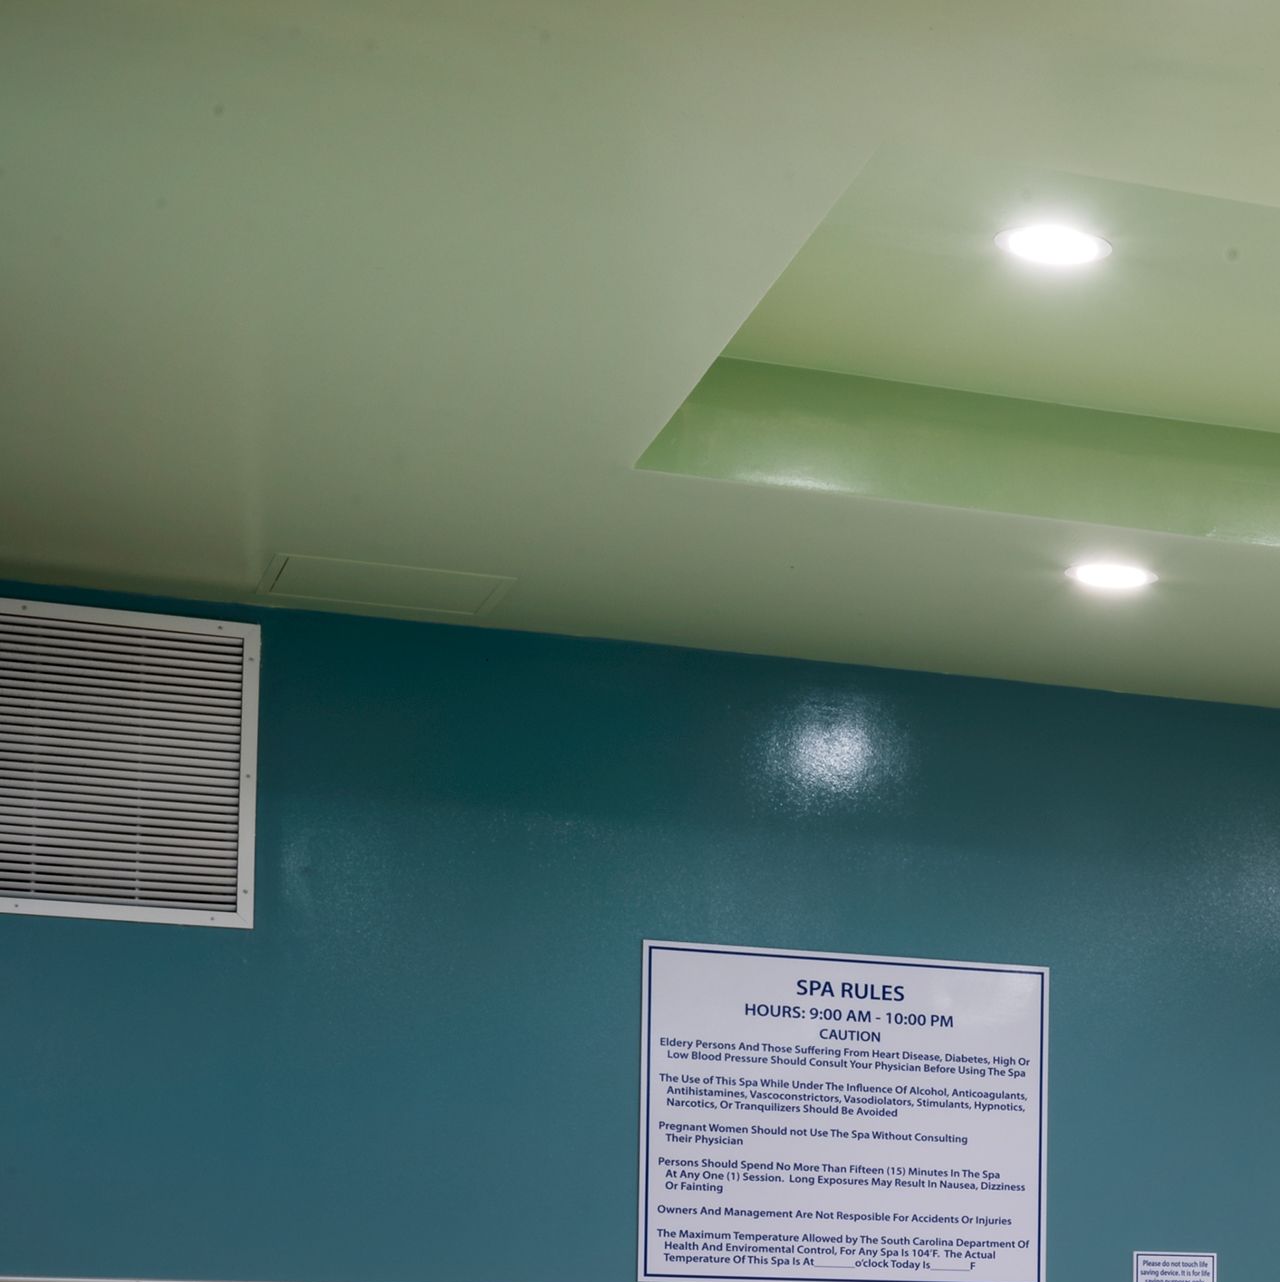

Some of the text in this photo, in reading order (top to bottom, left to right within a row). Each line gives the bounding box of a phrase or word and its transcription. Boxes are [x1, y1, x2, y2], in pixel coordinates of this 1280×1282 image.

[796, 978, 905, 1003] SPA RULES
[744, 1002, 806, 1020] HOURS:
[808, 1007, 843, 1022] 9:00
[845, 1008, 872, 1024] AM
[885, 1011, 927, 1027] 10:00
[930, 1014, 954, 1029] PM
[818, 1028, 881, 1043] CAUTION
[659, 1036, 1031, 1068] Eldery Persons And Those Suffering From Heart Disease, Diabetes, High Or
[666, 1049, 1027, 1080] Low Blood Pressure Should Consult Your Physician Before Using The Spa
[658, 1072, 1028, 1103] The Use of This Spa While Under The Influence Of Alcohol, Anticoagulants,
[666, 1085, 748, 1100] Antihistamines,
[749, 1089, 843, 1105] Vascoconstrictors,
[916, 1097, 972, 1111] Stimulants,
[973, 1100, 1026, 1113] Hypnotics,
[666, 1097, 899, 1118] Narcotics, Or Tranquilizers Should Be Avoided
[658, 1120, 969, 1146] Pregnant Women Should not Use The Spa Without Consulting
[664, 1132, 744, 1147] Their Physician
[656, 1204, 1013, 1227] Owners And Management Are Not Resposible For Accidents Or Injuries
[656, 1228, 1031, 1250] The Maximum Temperature Allowed by The South Carolina Department Of
[663, 1240, 700, 1252] Health
[700, 1241, 724, 1253] And
[725, 1242, 795, 1255] Enviromental
[796, 1244, 838, 1257] Control,
[839, 1245, 857, 1256] For
[857, 1246, 879, 1259] Any
[879, 1247, 900, 1259] Spa
[900, 1247, 910, 1258] Is
[943, 1248, 963, 1259] The
[963, 1249, 996, 1260] Actual
[663, 1252, 732, 1265] Temperature
[732, 1254, 747, 1265] Of
[746, 1254, 769, 1265] This
[770, 1255, 791, 1268] Spa
[889, 1259, 922, 1272] Today
